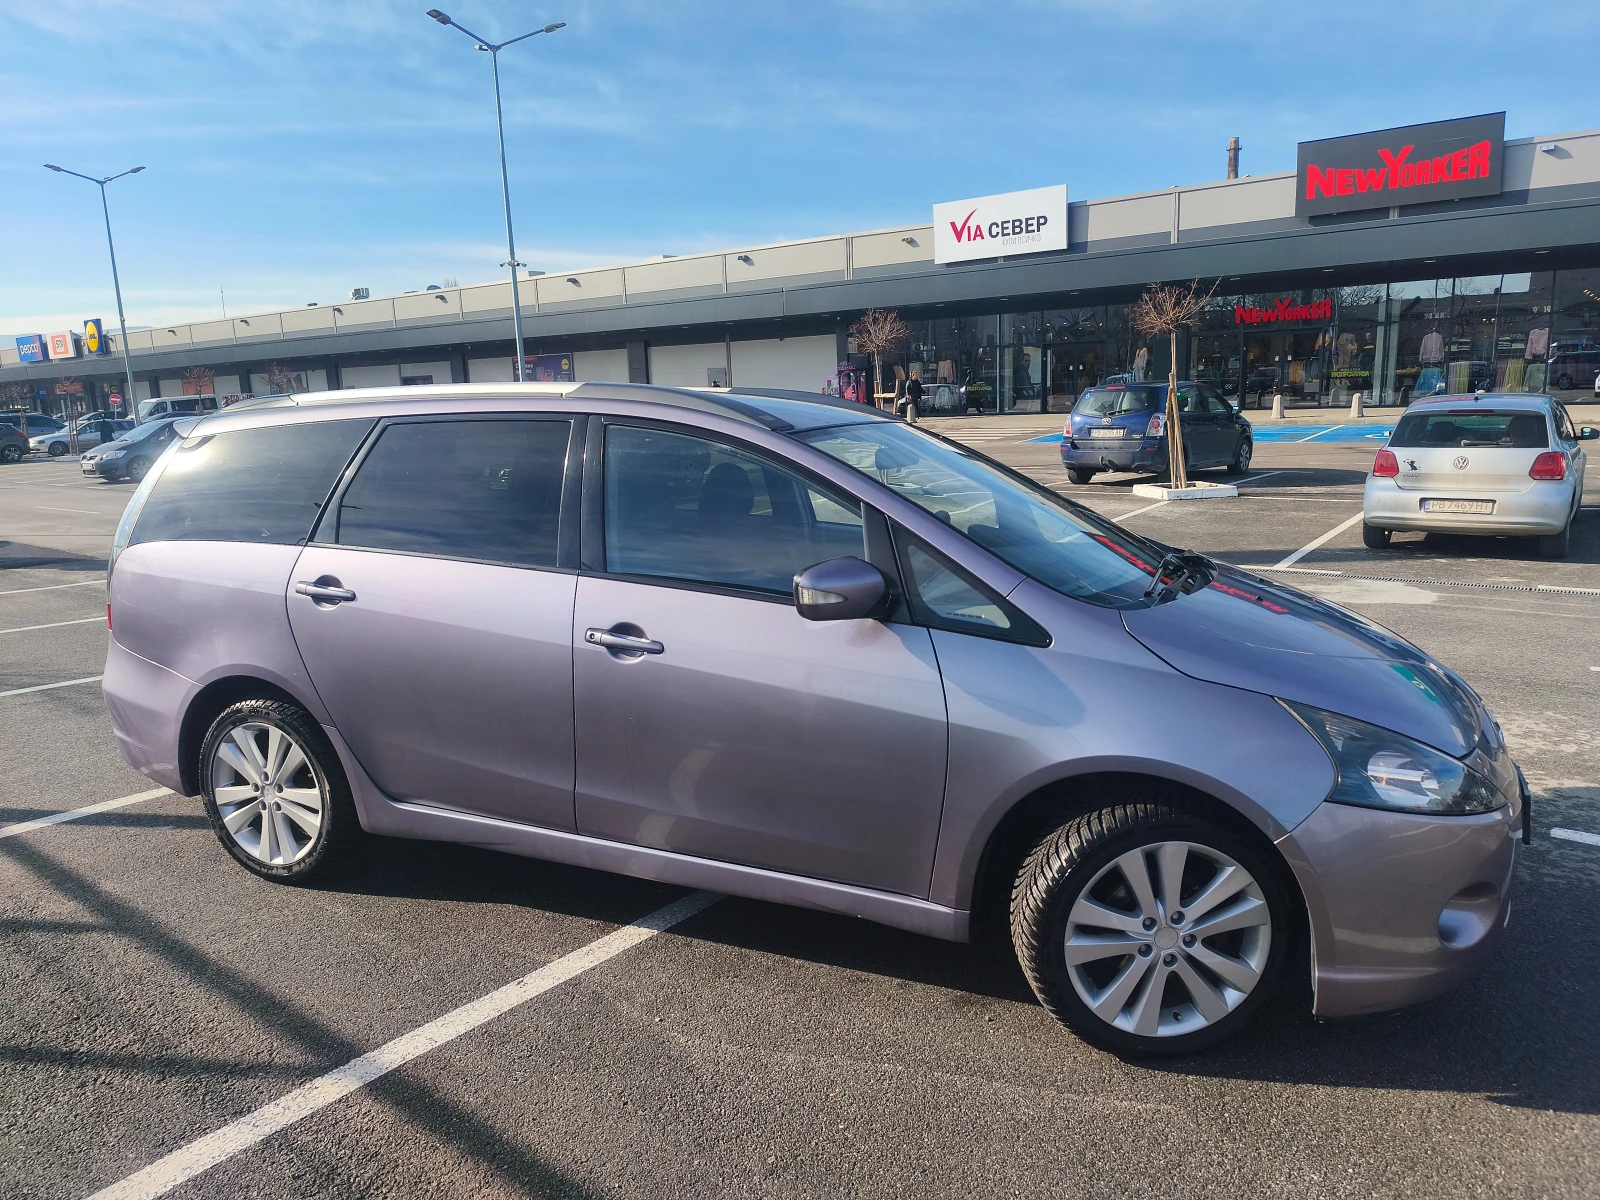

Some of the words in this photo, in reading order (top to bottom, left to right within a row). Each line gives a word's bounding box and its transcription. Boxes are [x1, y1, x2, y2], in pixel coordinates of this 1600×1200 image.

[950, 208, 985, 243] VIA
[988, 215, 1048, 239] СЕВЕР
[1447, 501, 1474, 510] 7469
